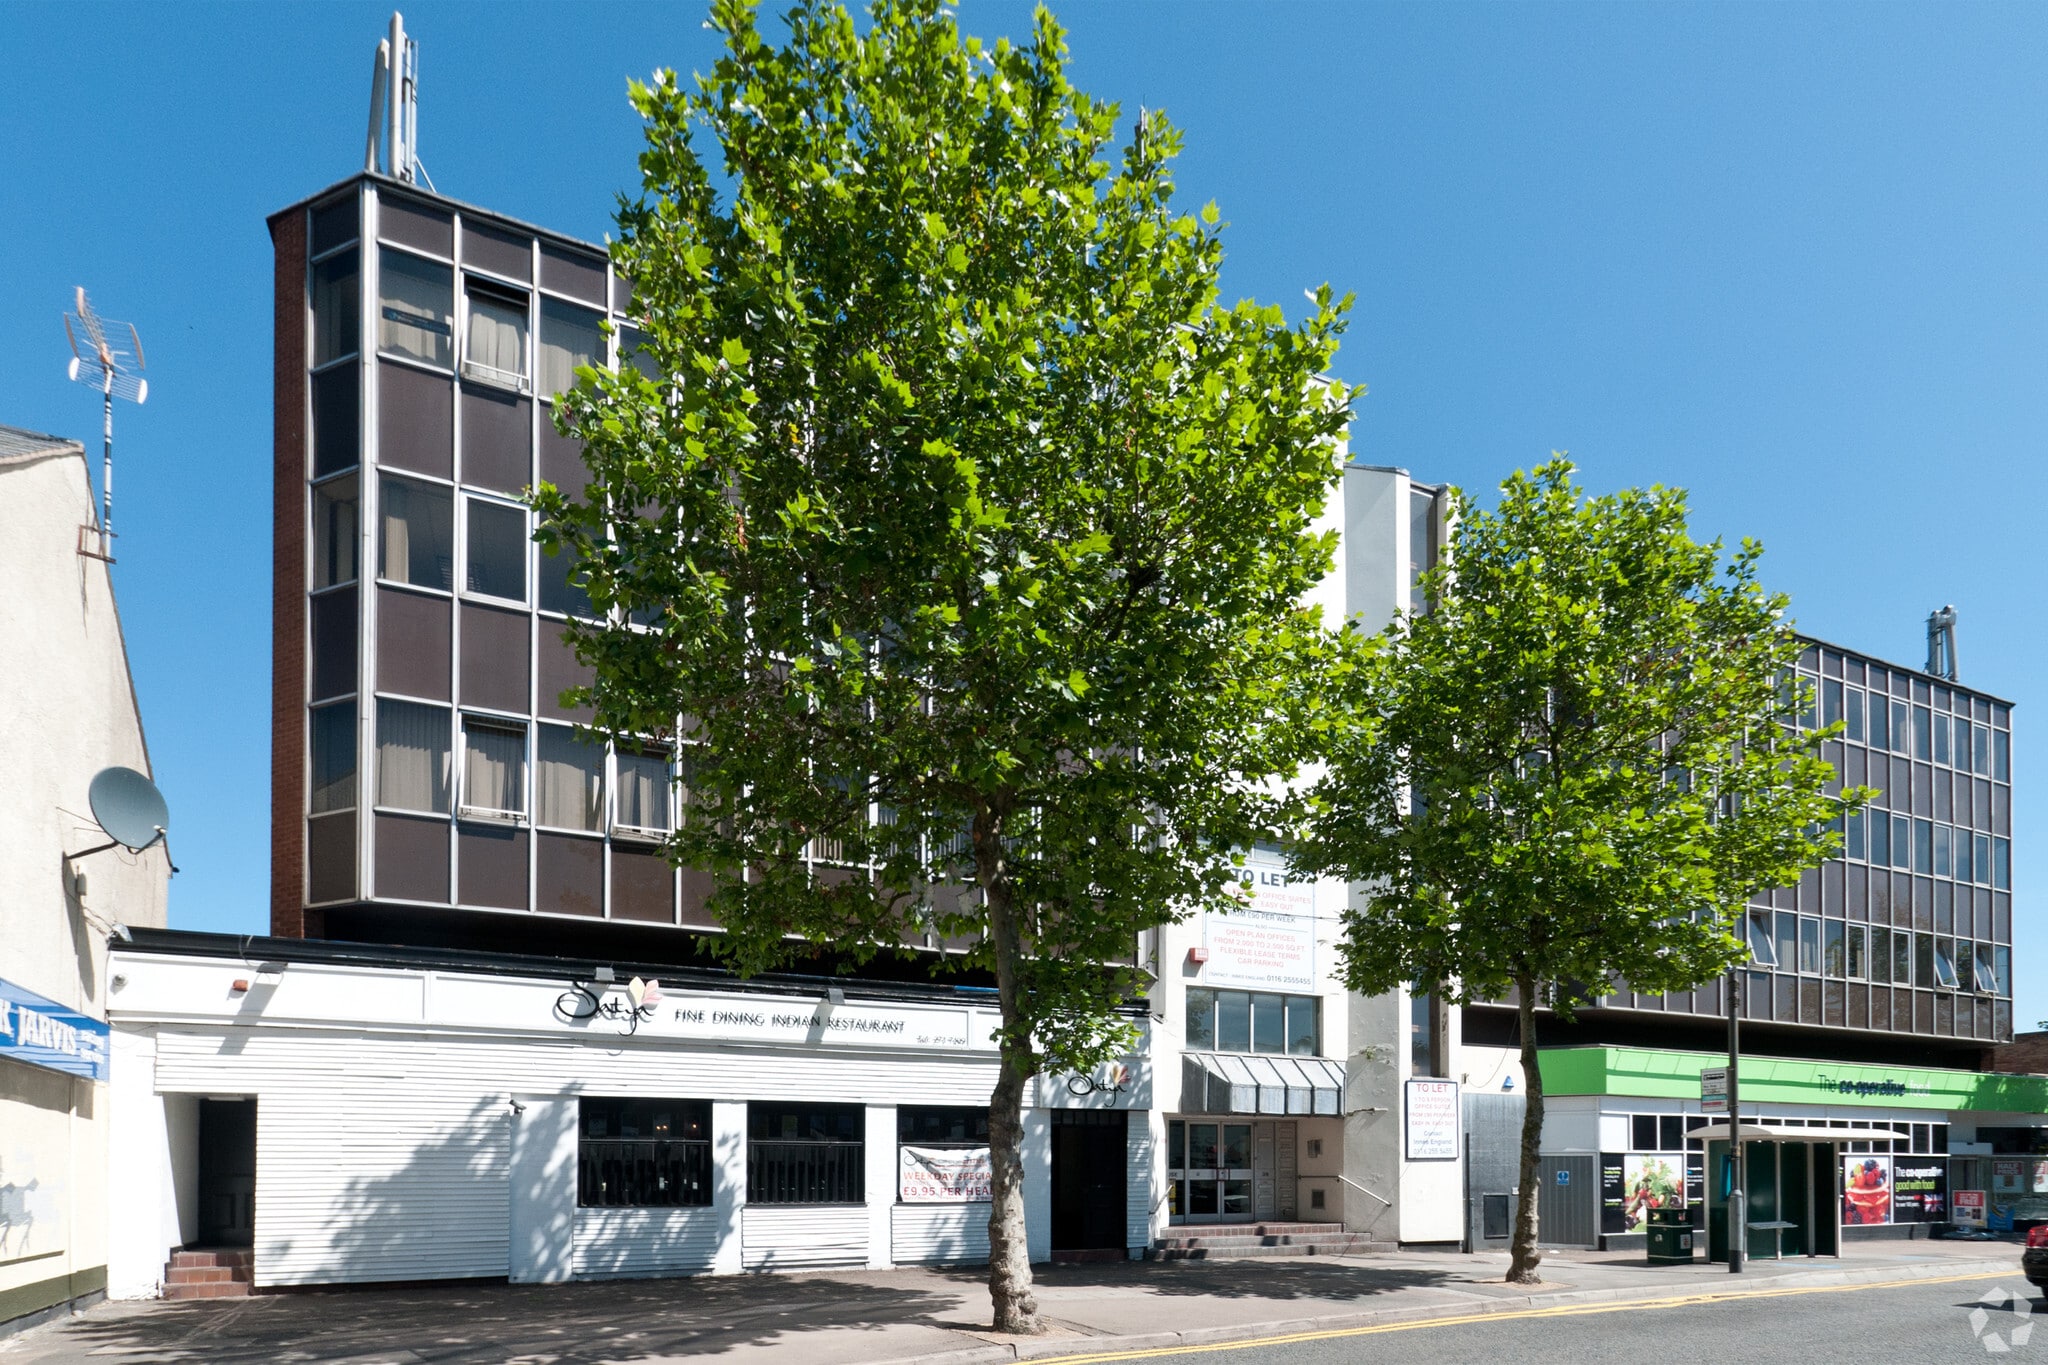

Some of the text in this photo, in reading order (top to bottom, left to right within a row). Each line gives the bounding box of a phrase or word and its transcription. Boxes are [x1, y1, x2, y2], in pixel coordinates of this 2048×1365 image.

[1232, 868, 1254, 883] TO
[1262, 892, 1312, 905] OFFICE SUITES
[1261, 901, 1278, 910] EASY
[1279, 903, 1294, 911] OUT
[1261, 913, 1276, 922] PER
[1277, 914, 1296, 924] WEEK
[1226, 929, 1296, 943] OPEN PLAN OFFICES
[1214, 936, 1235, 946] FROM
[1256, 941, 1266, 949] TO
[1285, 944, 1296, 952] SQ
[1220, 946, 1302, 961] FLEXIBLE LEASE TERMS
[1237, 957, 1285, 969] CAR PARKING
[1266, 974, 1283, 983] 0116
[557, 980, 654, 1036] Satya
[674, 1008, 906, 1034] FINE DINING INDIAN RESTAURANT
[17, 1005, 77, 1056] JARVIS
[1416, 1084, 1448, 1093] TO LET
[1818, 1074, 1930, 1098] The co-operative food
[1430, 1138, 1453, 1146] England
[903, 1172, 992, 1181] WEEKDAY SPECIA
[1895, 1166, 1943, 1179] The co-operative
[903, 1187, 992, 1197] £9.95 PER HEA
[1895, 1181, 1909, 1192] good
